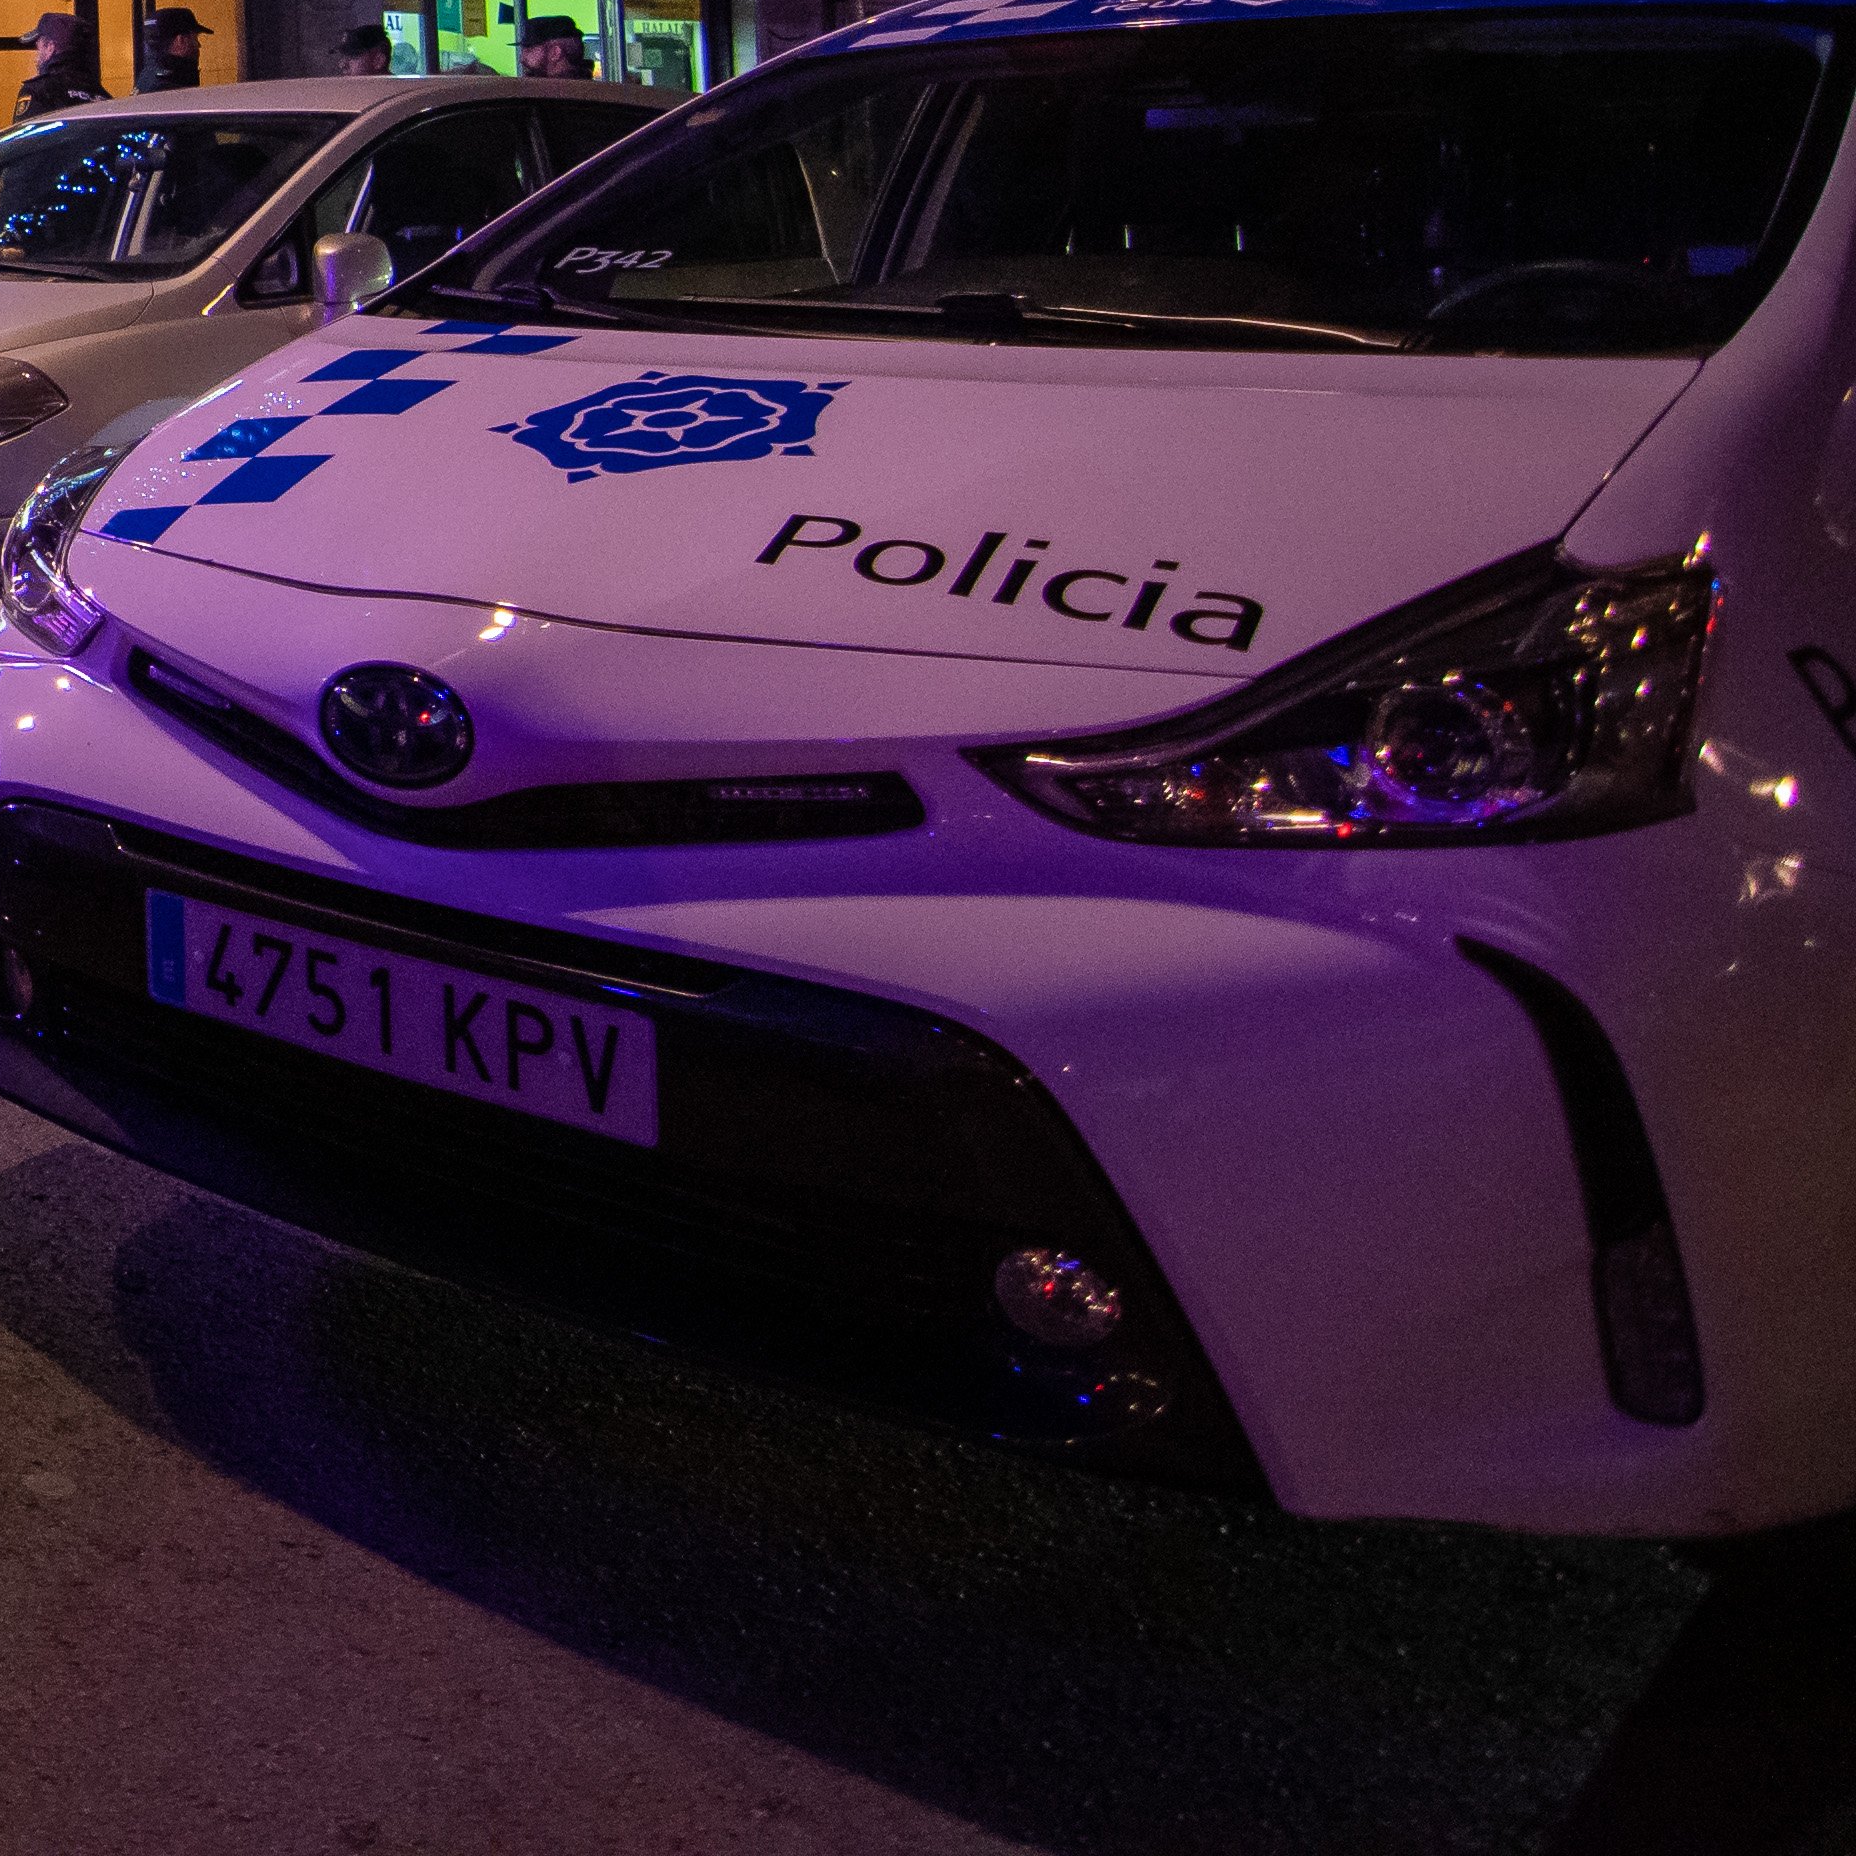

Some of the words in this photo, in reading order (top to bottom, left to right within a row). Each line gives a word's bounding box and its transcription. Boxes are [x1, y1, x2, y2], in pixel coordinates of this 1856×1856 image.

[554, 247, 673, 274] P342
[754, 513, 1264, 652] Policia
[204, 923, 392, 1056] 4751
[442, 983, 621, 1115] KPV
